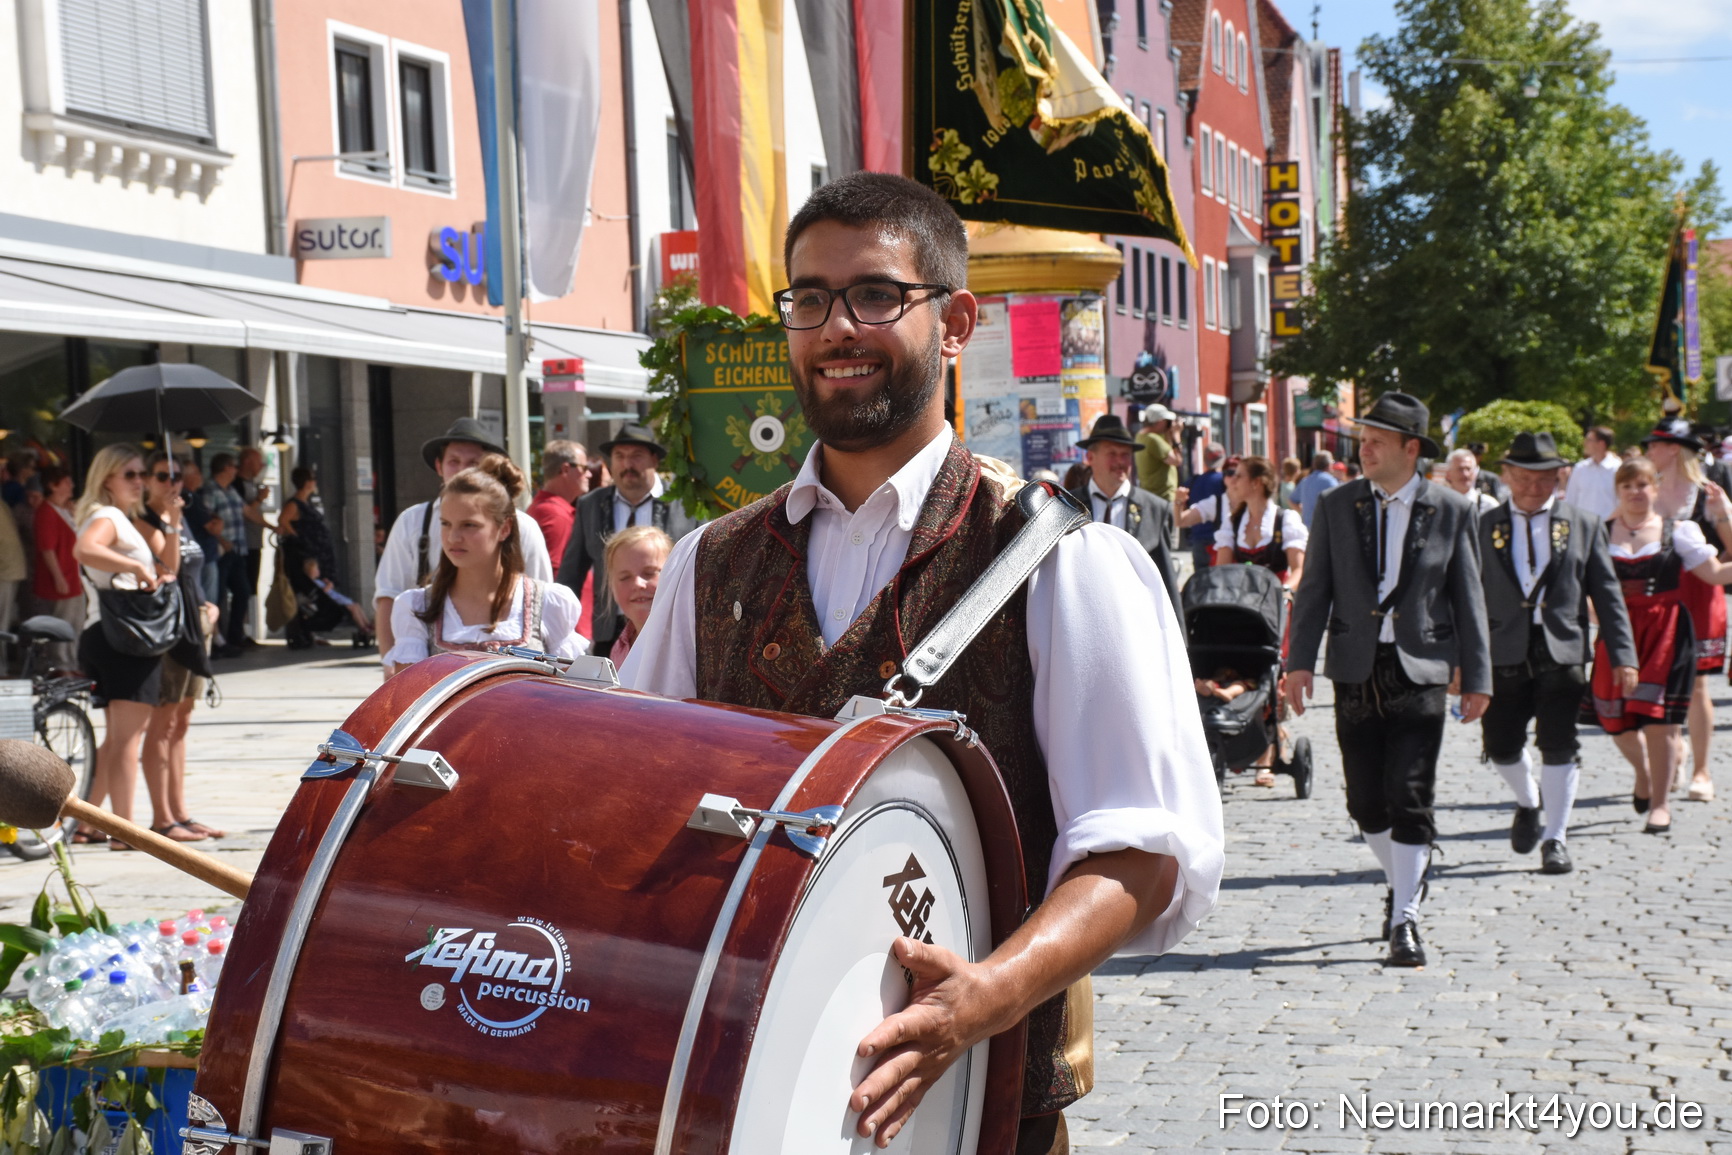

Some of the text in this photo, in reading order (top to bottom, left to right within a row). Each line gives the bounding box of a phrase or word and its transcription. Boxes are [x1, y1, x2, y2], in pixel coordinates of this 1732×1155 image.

[1269, 163, 1301, 336] HOTEL
[405, 927, 555, 985] Lefima
[517, 916, 571, 972] www.lefima.net
[456, 1003, 537, 1038] MADE IN GERMANY
[476, 981, 591, 1013] percussion
